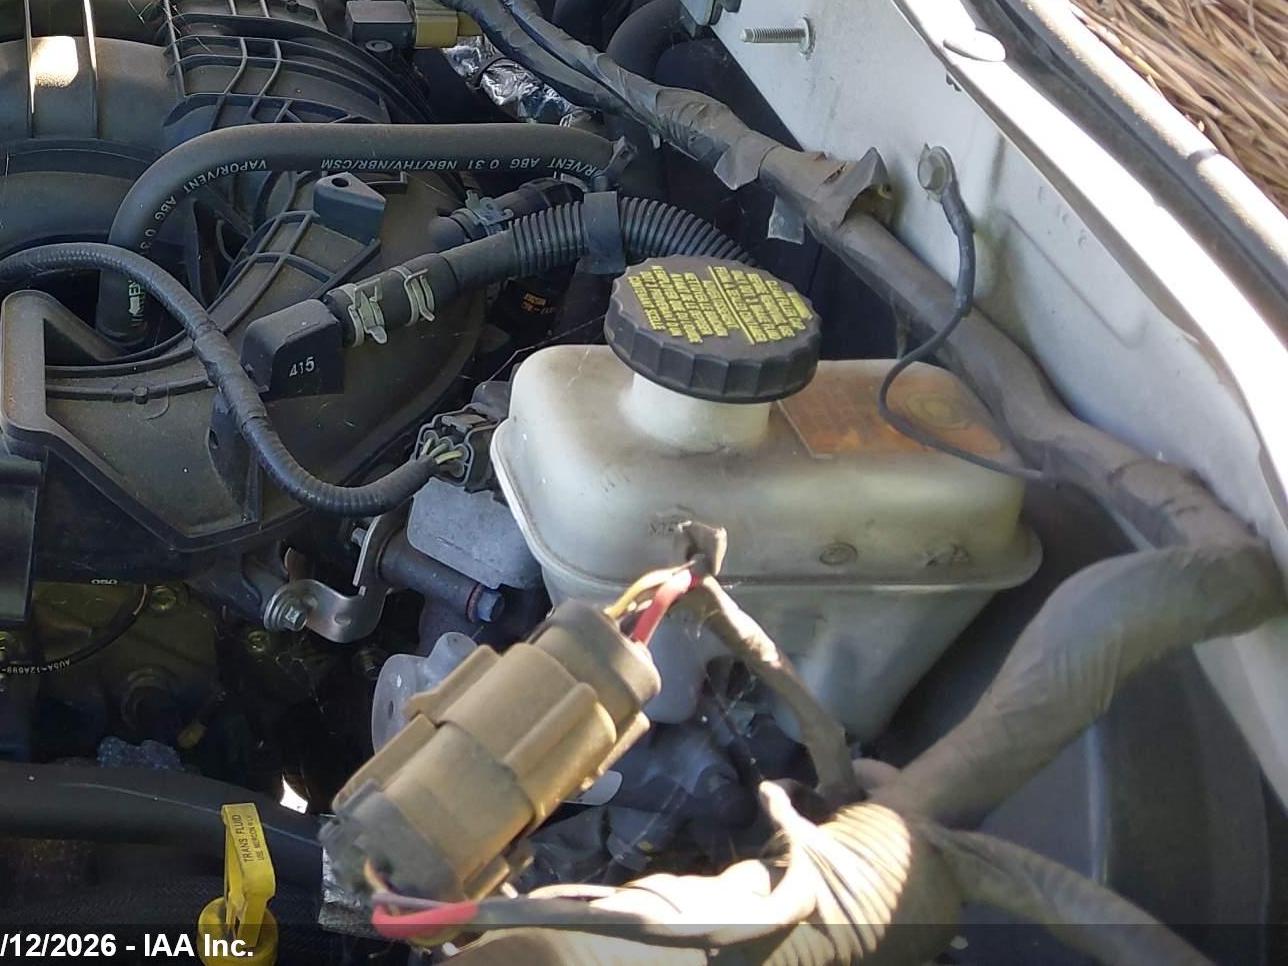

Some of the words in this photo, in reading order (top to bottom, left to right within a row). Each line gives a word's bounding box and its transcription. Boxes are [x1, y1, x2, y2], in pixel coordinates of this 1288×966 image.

[320, 158, 457, 171] NBR/THV/NBR/CSM
[467, 160, 486, 170] 31
[510, 157, 541, 169] ABG
[181, 159, 268, 195] VAPOR/VENT
[153, 197, 178, 222] ABG
[289, 356, 315, 377] 415
[232, 814, 246, 835] FLUID
[239, 838, 254, 863] TRANS
